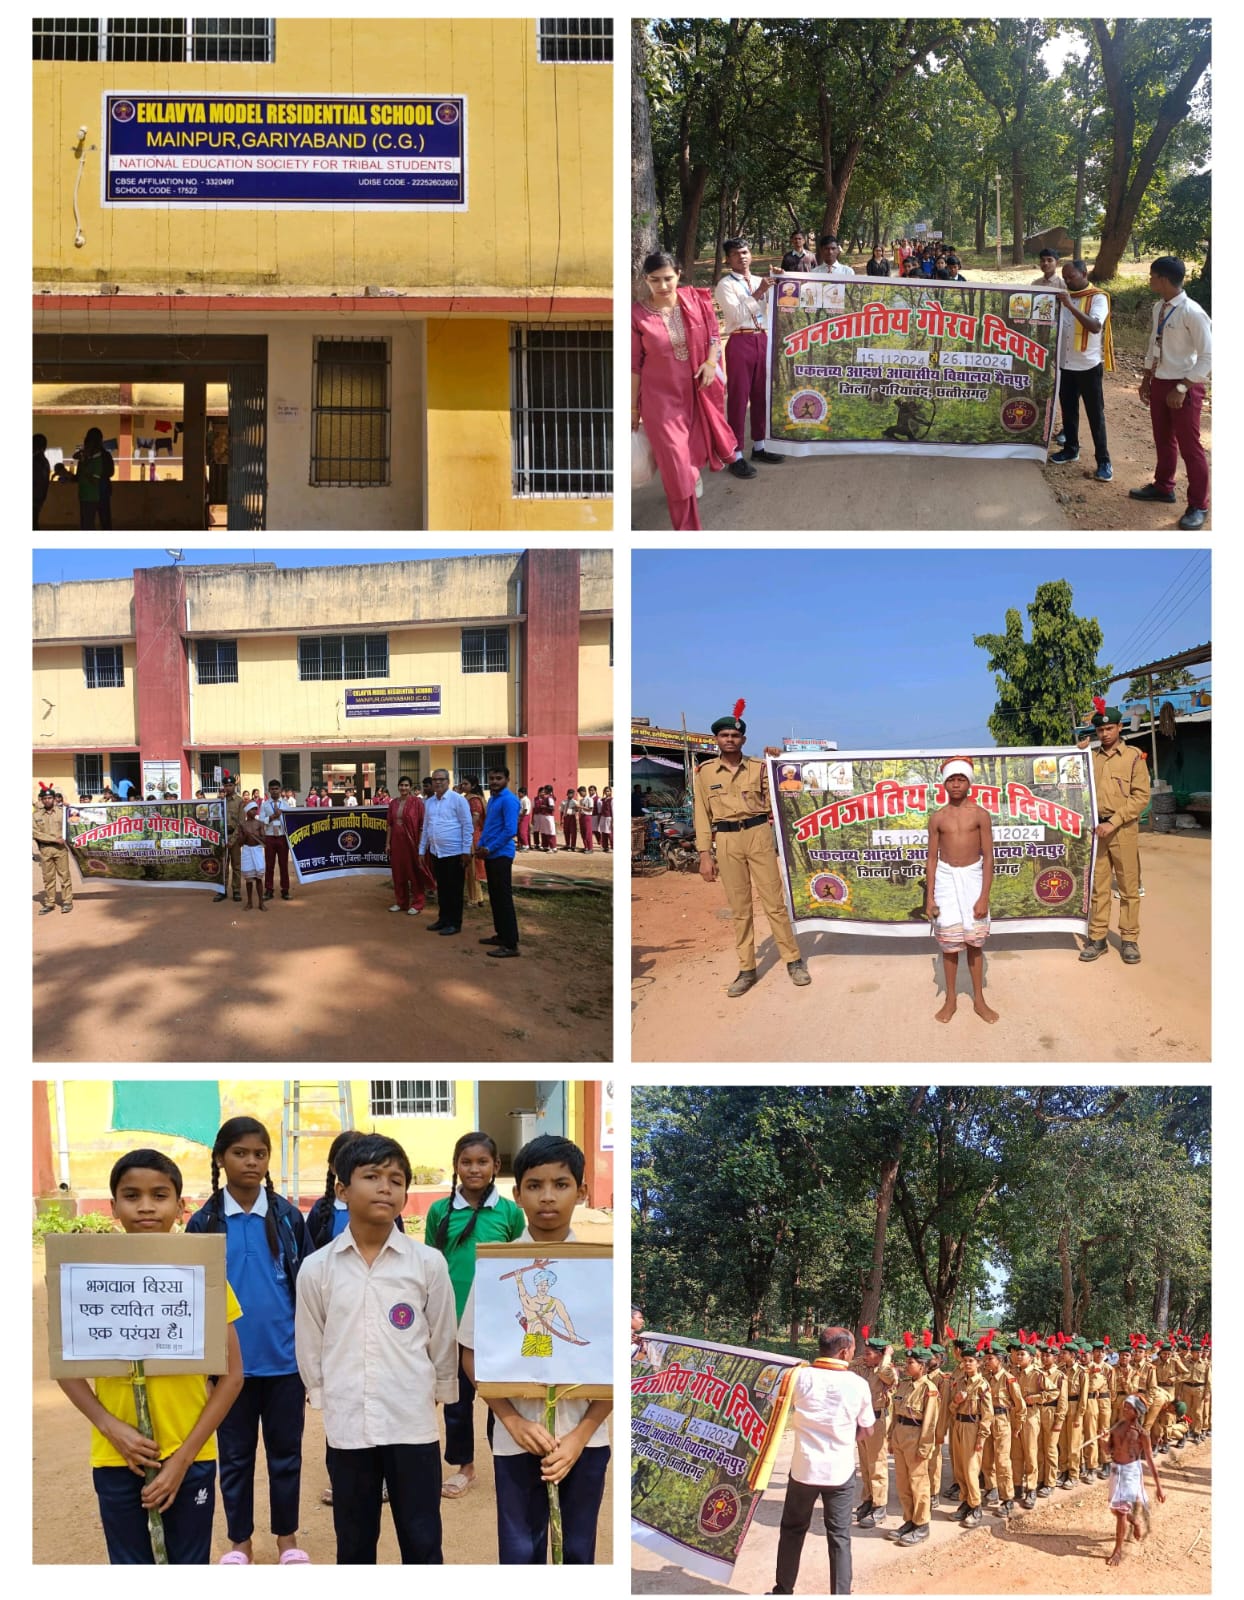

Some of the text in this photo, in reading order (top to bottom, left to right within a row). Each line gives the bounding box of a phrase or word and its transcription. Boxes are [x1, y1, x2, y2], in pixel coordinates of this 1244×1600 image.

[137, 102, 434, 126] EKLAVYA MODEL RESIDENTIAL SCHOOL
[146, 131, 425, 152] MAINPUR,GARIYABAND (C.G.)
[119, 158, 452, 170] NATIONAL EDUCATION SOCIETY FOR TRIBAL STUDENTS
[358, 178, 381, 186] UDISE
[383, 178, 406, 186] CODE
[784, 301, 1049, 371] जनजातिय गौरव दिवस
[794, 364, 1031, 389] एकलव्य आदर्श आवासीय विद्यालय मैनपुर
[839, 382, 869, 394] जिला
[793, 780, 929, 842] जनजातिय
[1005, 781, 1084, 839] दिवस
[332, 812, 361, 830] आवासीय
[72, 813, 220, 848] जनजातिय गौरव दिवस
[809, 849, 859, 861] एकलव्य
[863, 847, 902, 861] आदर्श
[1025, 842, 1064, 860] मैनपुर
[856, 865, 891, 878] जिला
[86, 1275, 184, 1293] भगवान बिरसा
[79, 1303, 105, 1317] एक
[88, 1326, 113, 1340] एक
[120, 1324, 161, 1340] परंपरा
[631, 1362, 694, 1396] नजातिय
[690, 1365, 732, 1412] गौरव
[682, 1436, 715, 1460] विद्यालय
[716, 1448, 747, 1476] मैनपुर
